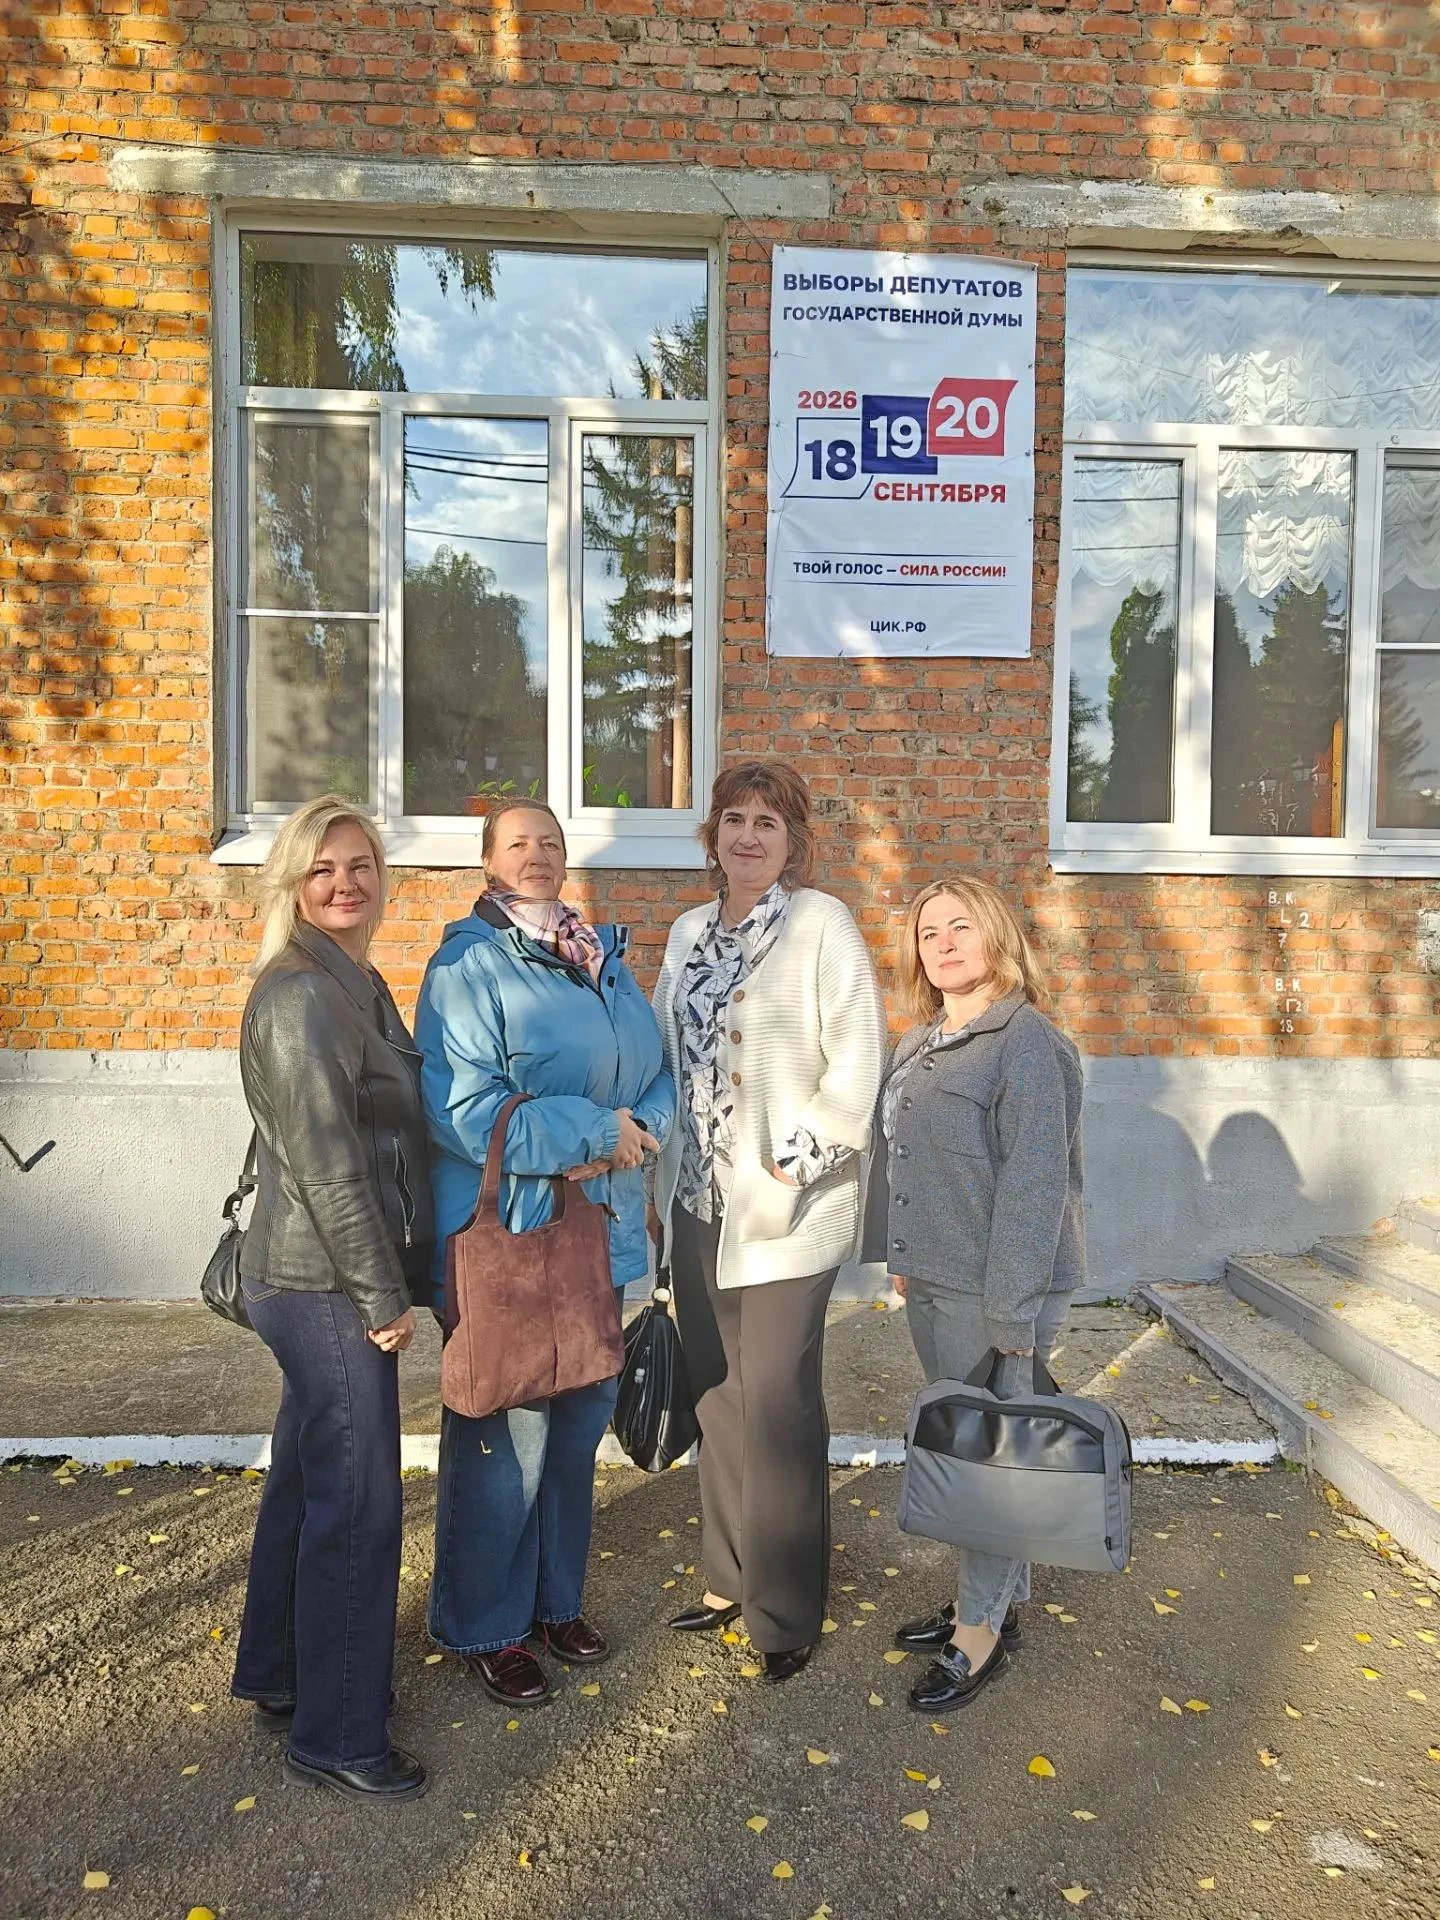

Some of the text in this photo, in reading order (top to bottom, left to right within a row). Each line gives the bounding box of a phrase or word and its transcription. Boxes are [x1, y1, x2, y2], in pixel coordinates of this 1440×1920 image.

[783, 273, 1023, 298] ВЫБОРЫ ДЕПУТАТОВ
[783, 306, 1023, 327] ГОСУДАРСТВЕННОЙ ДУМЫ
[797, 390, 857, 409] 2026
[804, 396, 999, 481] 18 19 20
[873, 482, 1006, 504] СЕНТЯБРЯ
[793, 561, 832, 574] ТВОЙ
[835, 563, 883, 575] ГОЛОС
[899, 564, 940, 577] СИЛА
[942, 565, 1006, 577] РОССИИ!
[870, 620, 926, 633] ЦИК.РФ
